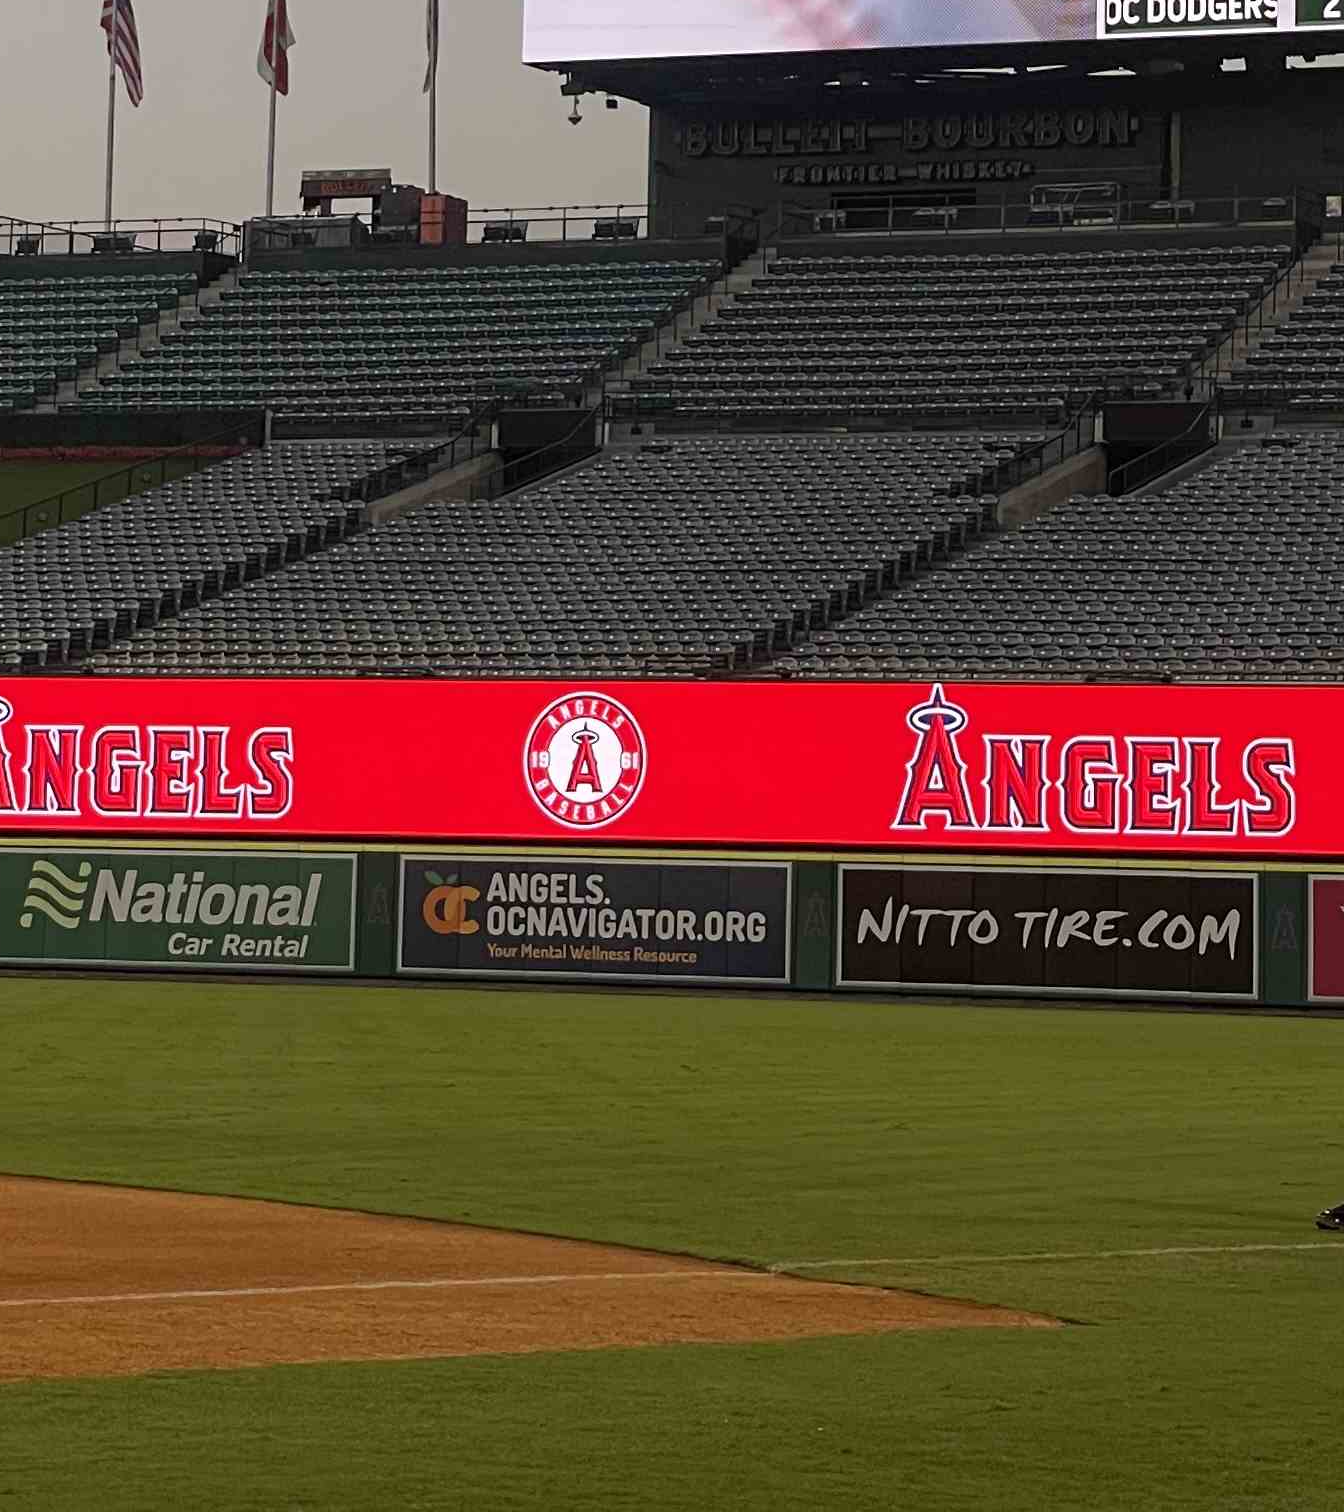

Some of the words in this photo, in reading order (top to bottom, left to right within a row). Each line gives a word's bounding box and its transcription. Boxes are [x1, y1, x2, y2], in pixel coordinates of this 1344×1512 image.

[903, 105, 1132, 151] BOURBON
[547, 698, 625, 729] ANGELS
[529, 751, 549, 769] 19
[621, 751, 641, 770] 61
[535, 778, 635, 821] BASEBALL
[88, 869, 323, 927] National
[486, 872, 611, 906] ANGELS.
[486, 905, 768, 943] OCNAVIGATOR.ORG
[857, 896, 1001, 946] NITTO
[1013, 906, 1242, 962] TIRE.COM
[167, 932, 212, 956] Car
[221, 934, 309, 958] Rental
[487, 943, 518, 959] Your
[520, 943, 567, 960] Mental
[569, 944, 631, 962] Wellness
[634, 946, 697, 964] Resource
